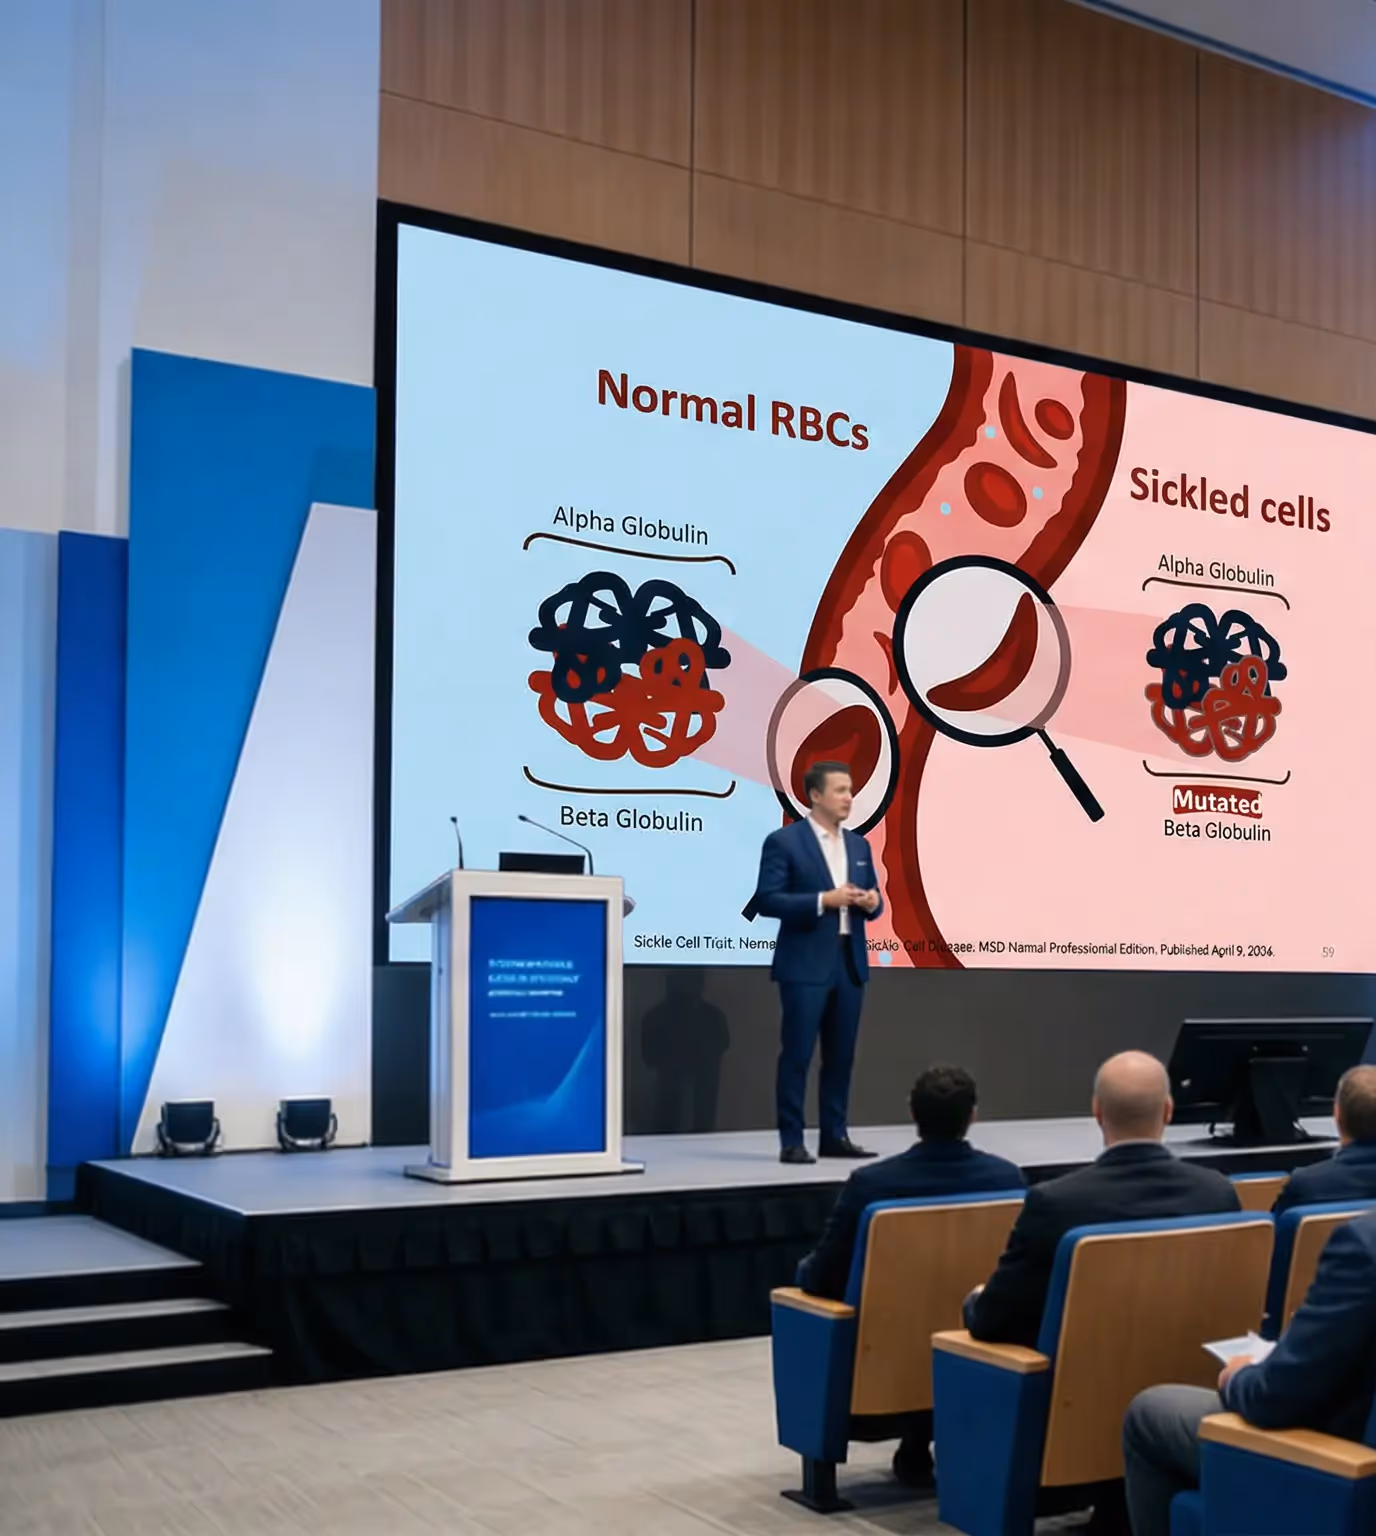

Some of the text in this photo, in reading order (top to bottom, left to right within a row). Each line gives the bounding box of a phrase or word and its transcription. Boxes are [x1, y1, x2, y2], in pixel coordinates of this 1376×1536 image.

[598, 368, 869, 451] Normal RBCs
[1130, 466, 1331, 532] Sickled cells
[552, 505, 708, 546] Alpha Globulin
[1158, 553, 1275, 587] Alpha Globulin
[1173, 788, 1262, 814] Mutated
[560, 805, 703, 832] Beta Globulin
[1164, 818, 1271, 842] Beta Globulin
[634, 934, 673, 949] Sickle
[675, 935, 701, 949] Cell
[978, 940, 1006, 954] MSD
[1322, 946, 1336, 958] 59
